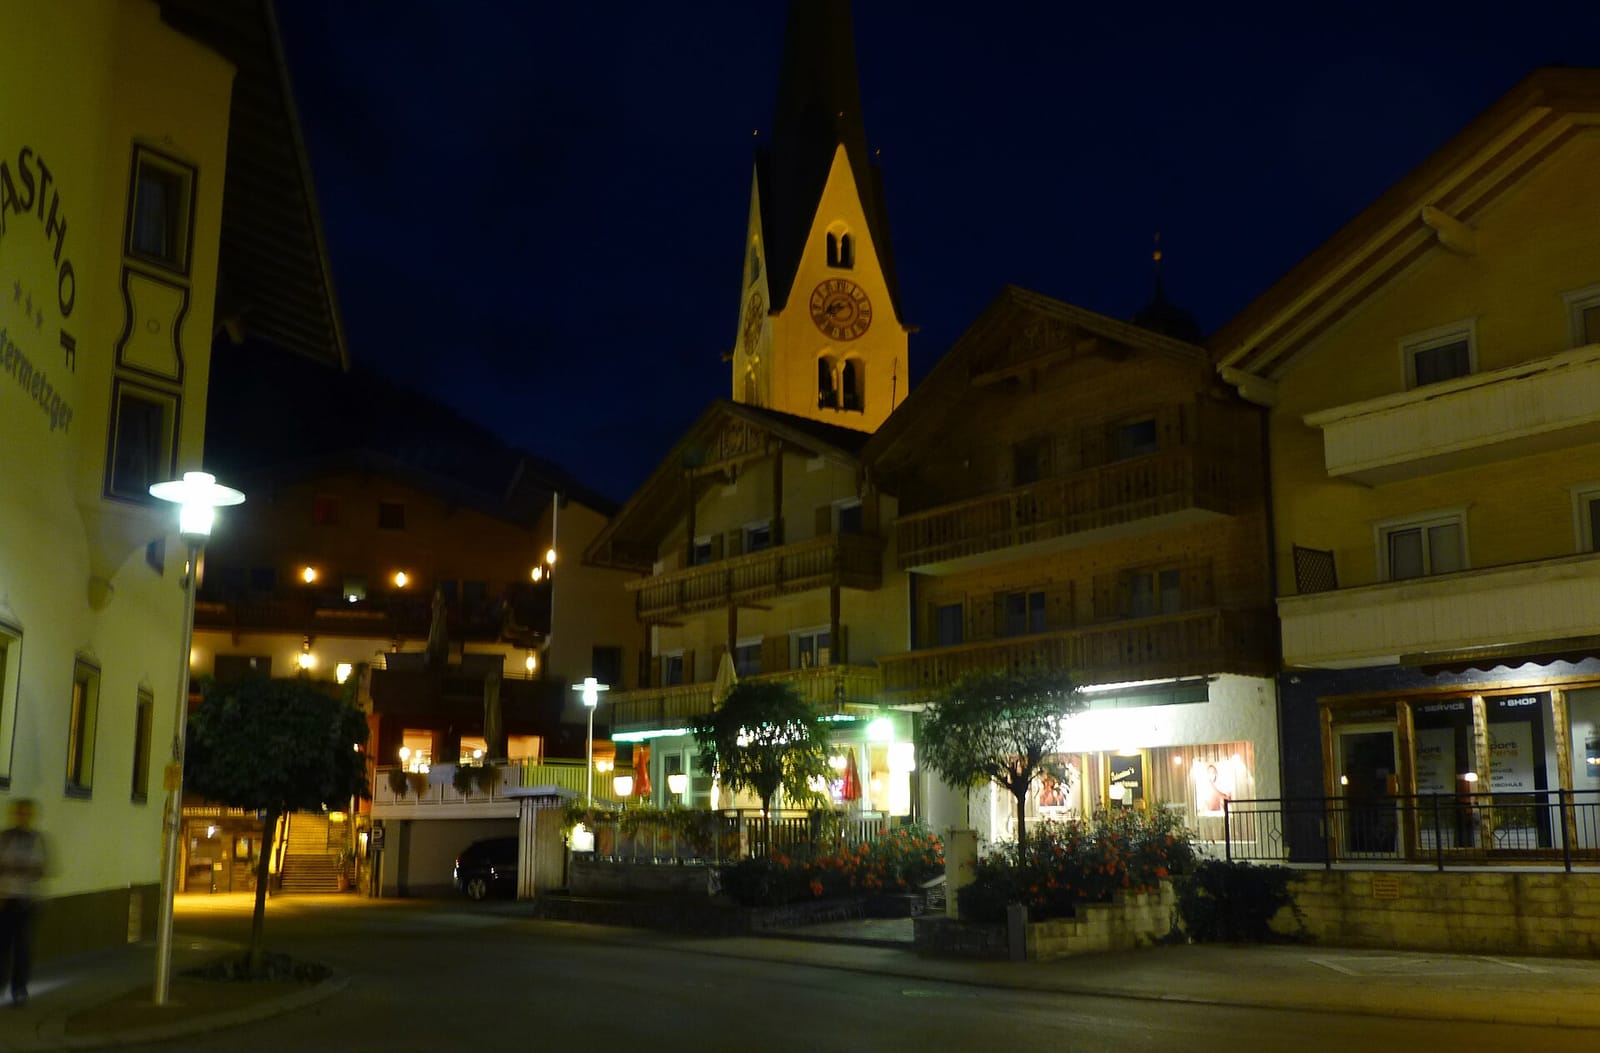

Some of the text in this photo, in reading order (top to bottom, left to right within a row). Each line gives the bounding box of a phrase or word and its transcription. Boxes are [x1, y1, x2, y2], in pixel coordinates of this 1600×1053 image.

[0, 146, 76, 373] ASTHOF
[0, 328, 73, 434] termetzger
[1424, 702, 1465, 712] SERVICE
[1507, 697, 1537, 707] SHOP
[1488, 741, 1519, 752] port
